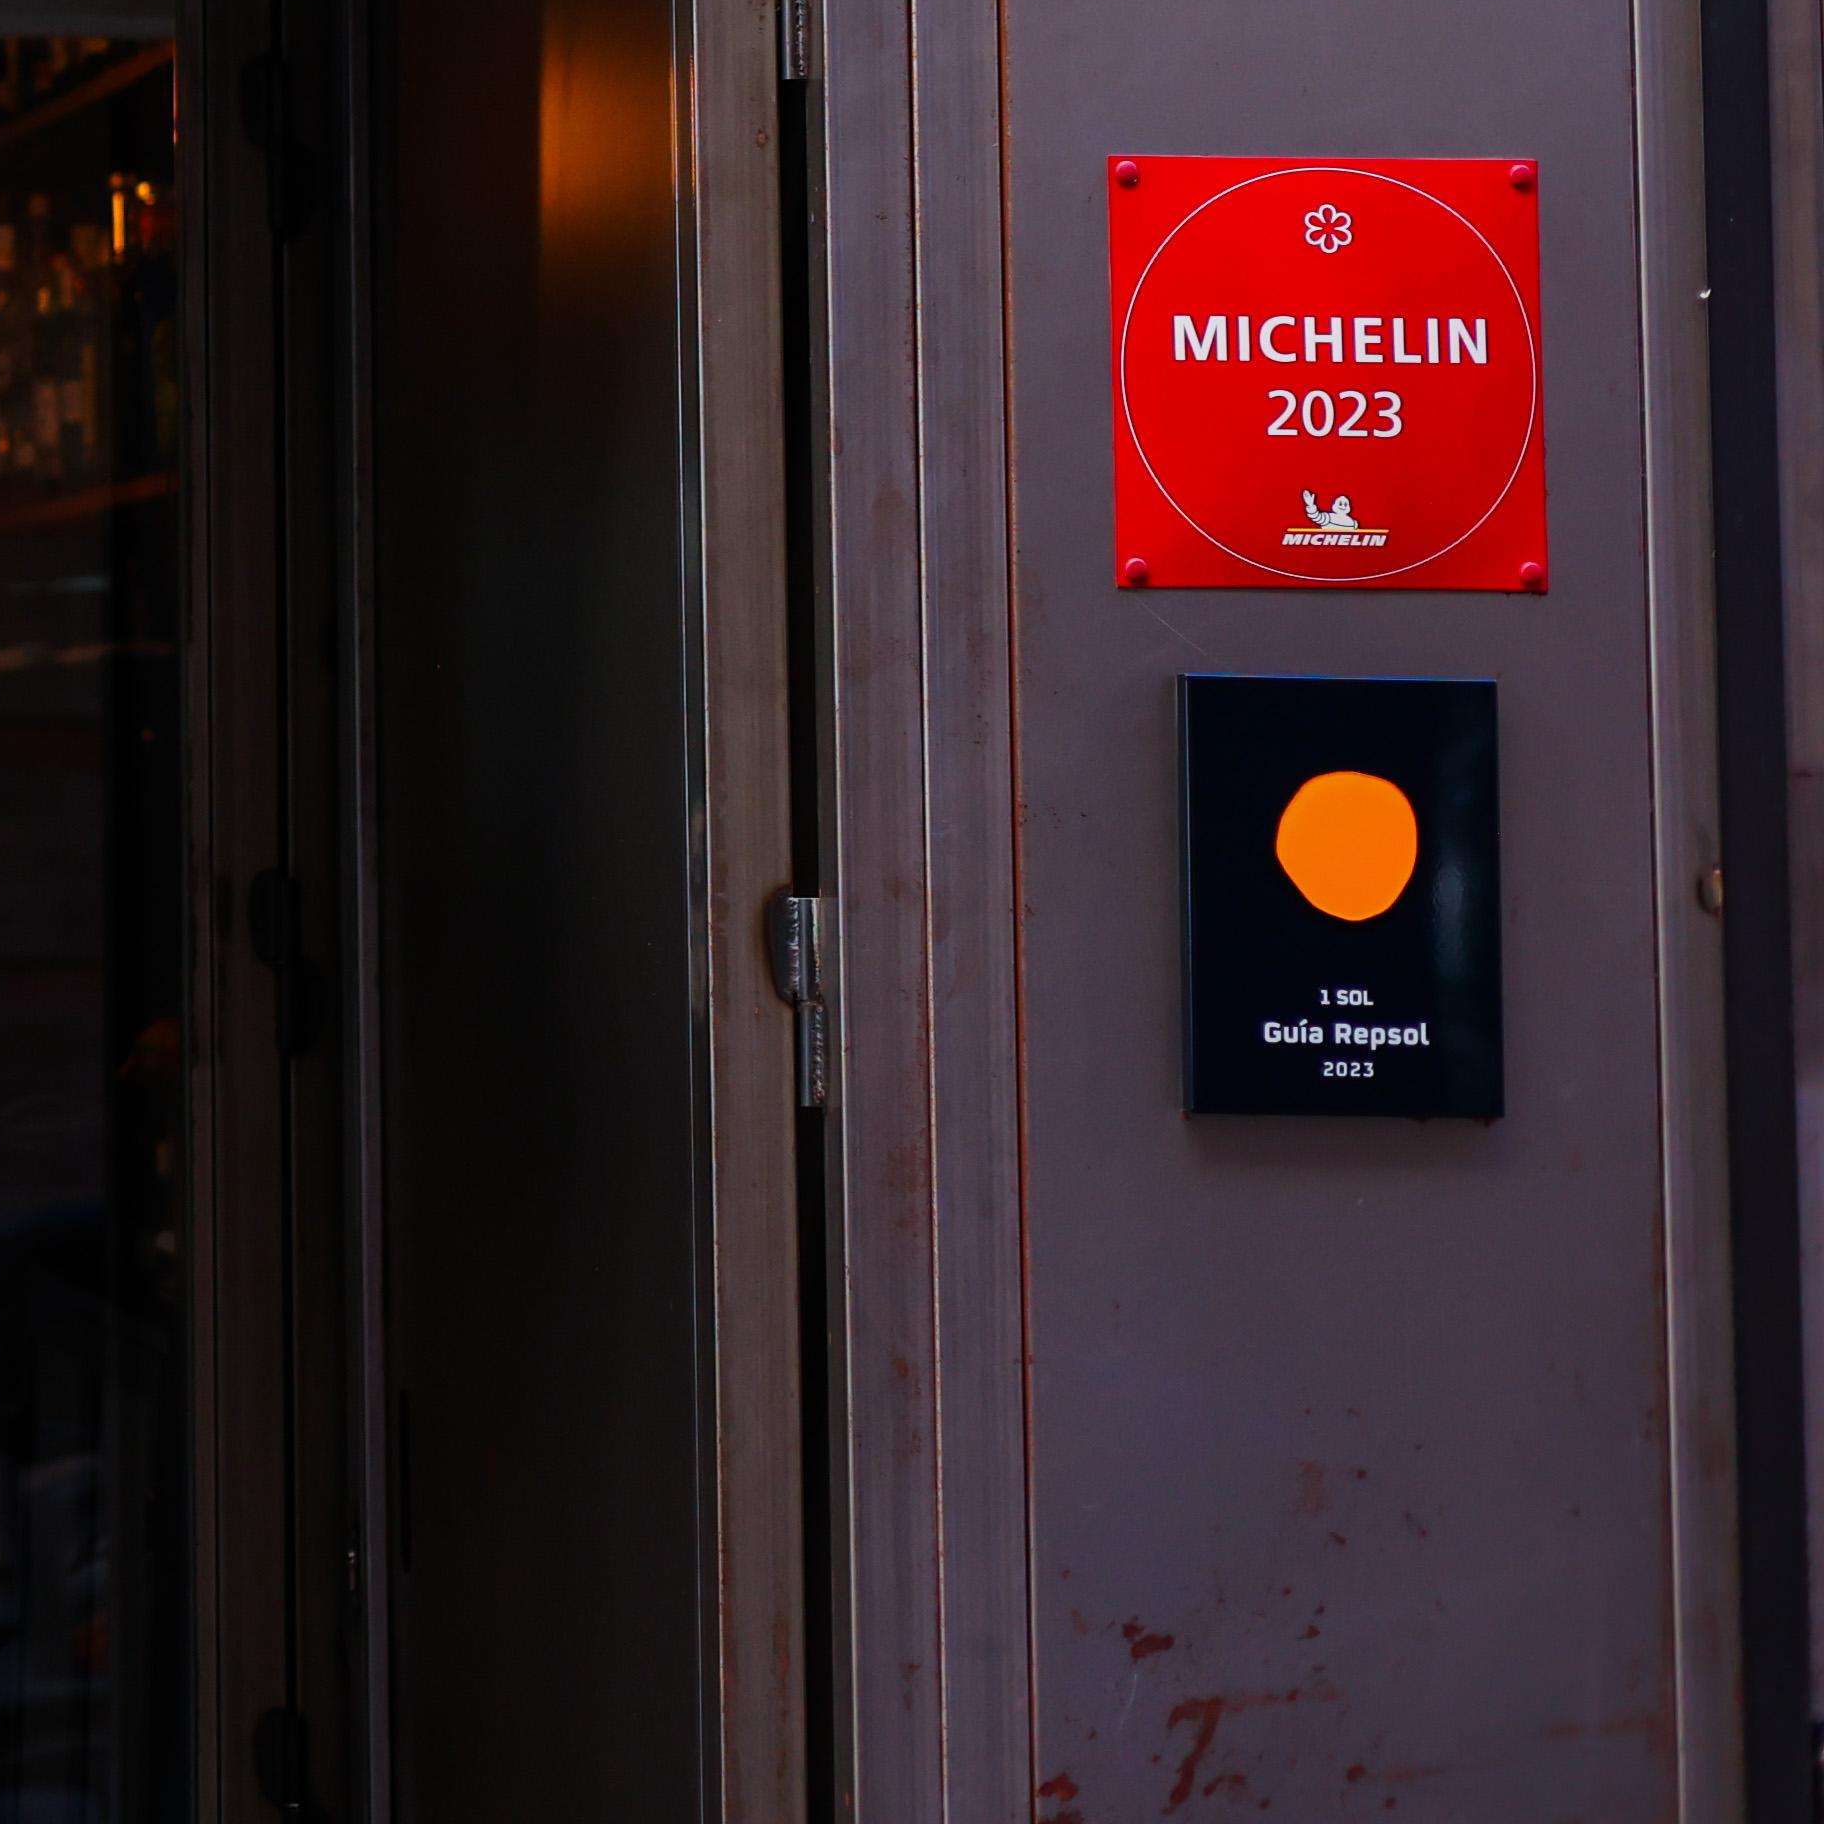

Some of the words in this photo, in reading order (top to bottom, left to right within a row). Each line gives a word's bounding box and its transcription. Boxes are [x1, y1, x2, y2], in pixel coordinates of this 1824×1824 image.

[1173, 315, 1487, 364] MICHELIN
[1267, 389, 1402, 438] 2023
[1281, 533, 1387, 547] MICHELIN
[1320, 989, 1331, 1006] 1
[1336, 989, 1375, 1007] SOL
[1263, 1018, 1324, 1044] Guía
[1334, 1022, 1430, 1051] Repsol
[1323, 1061, 1375, 1078] 2023
